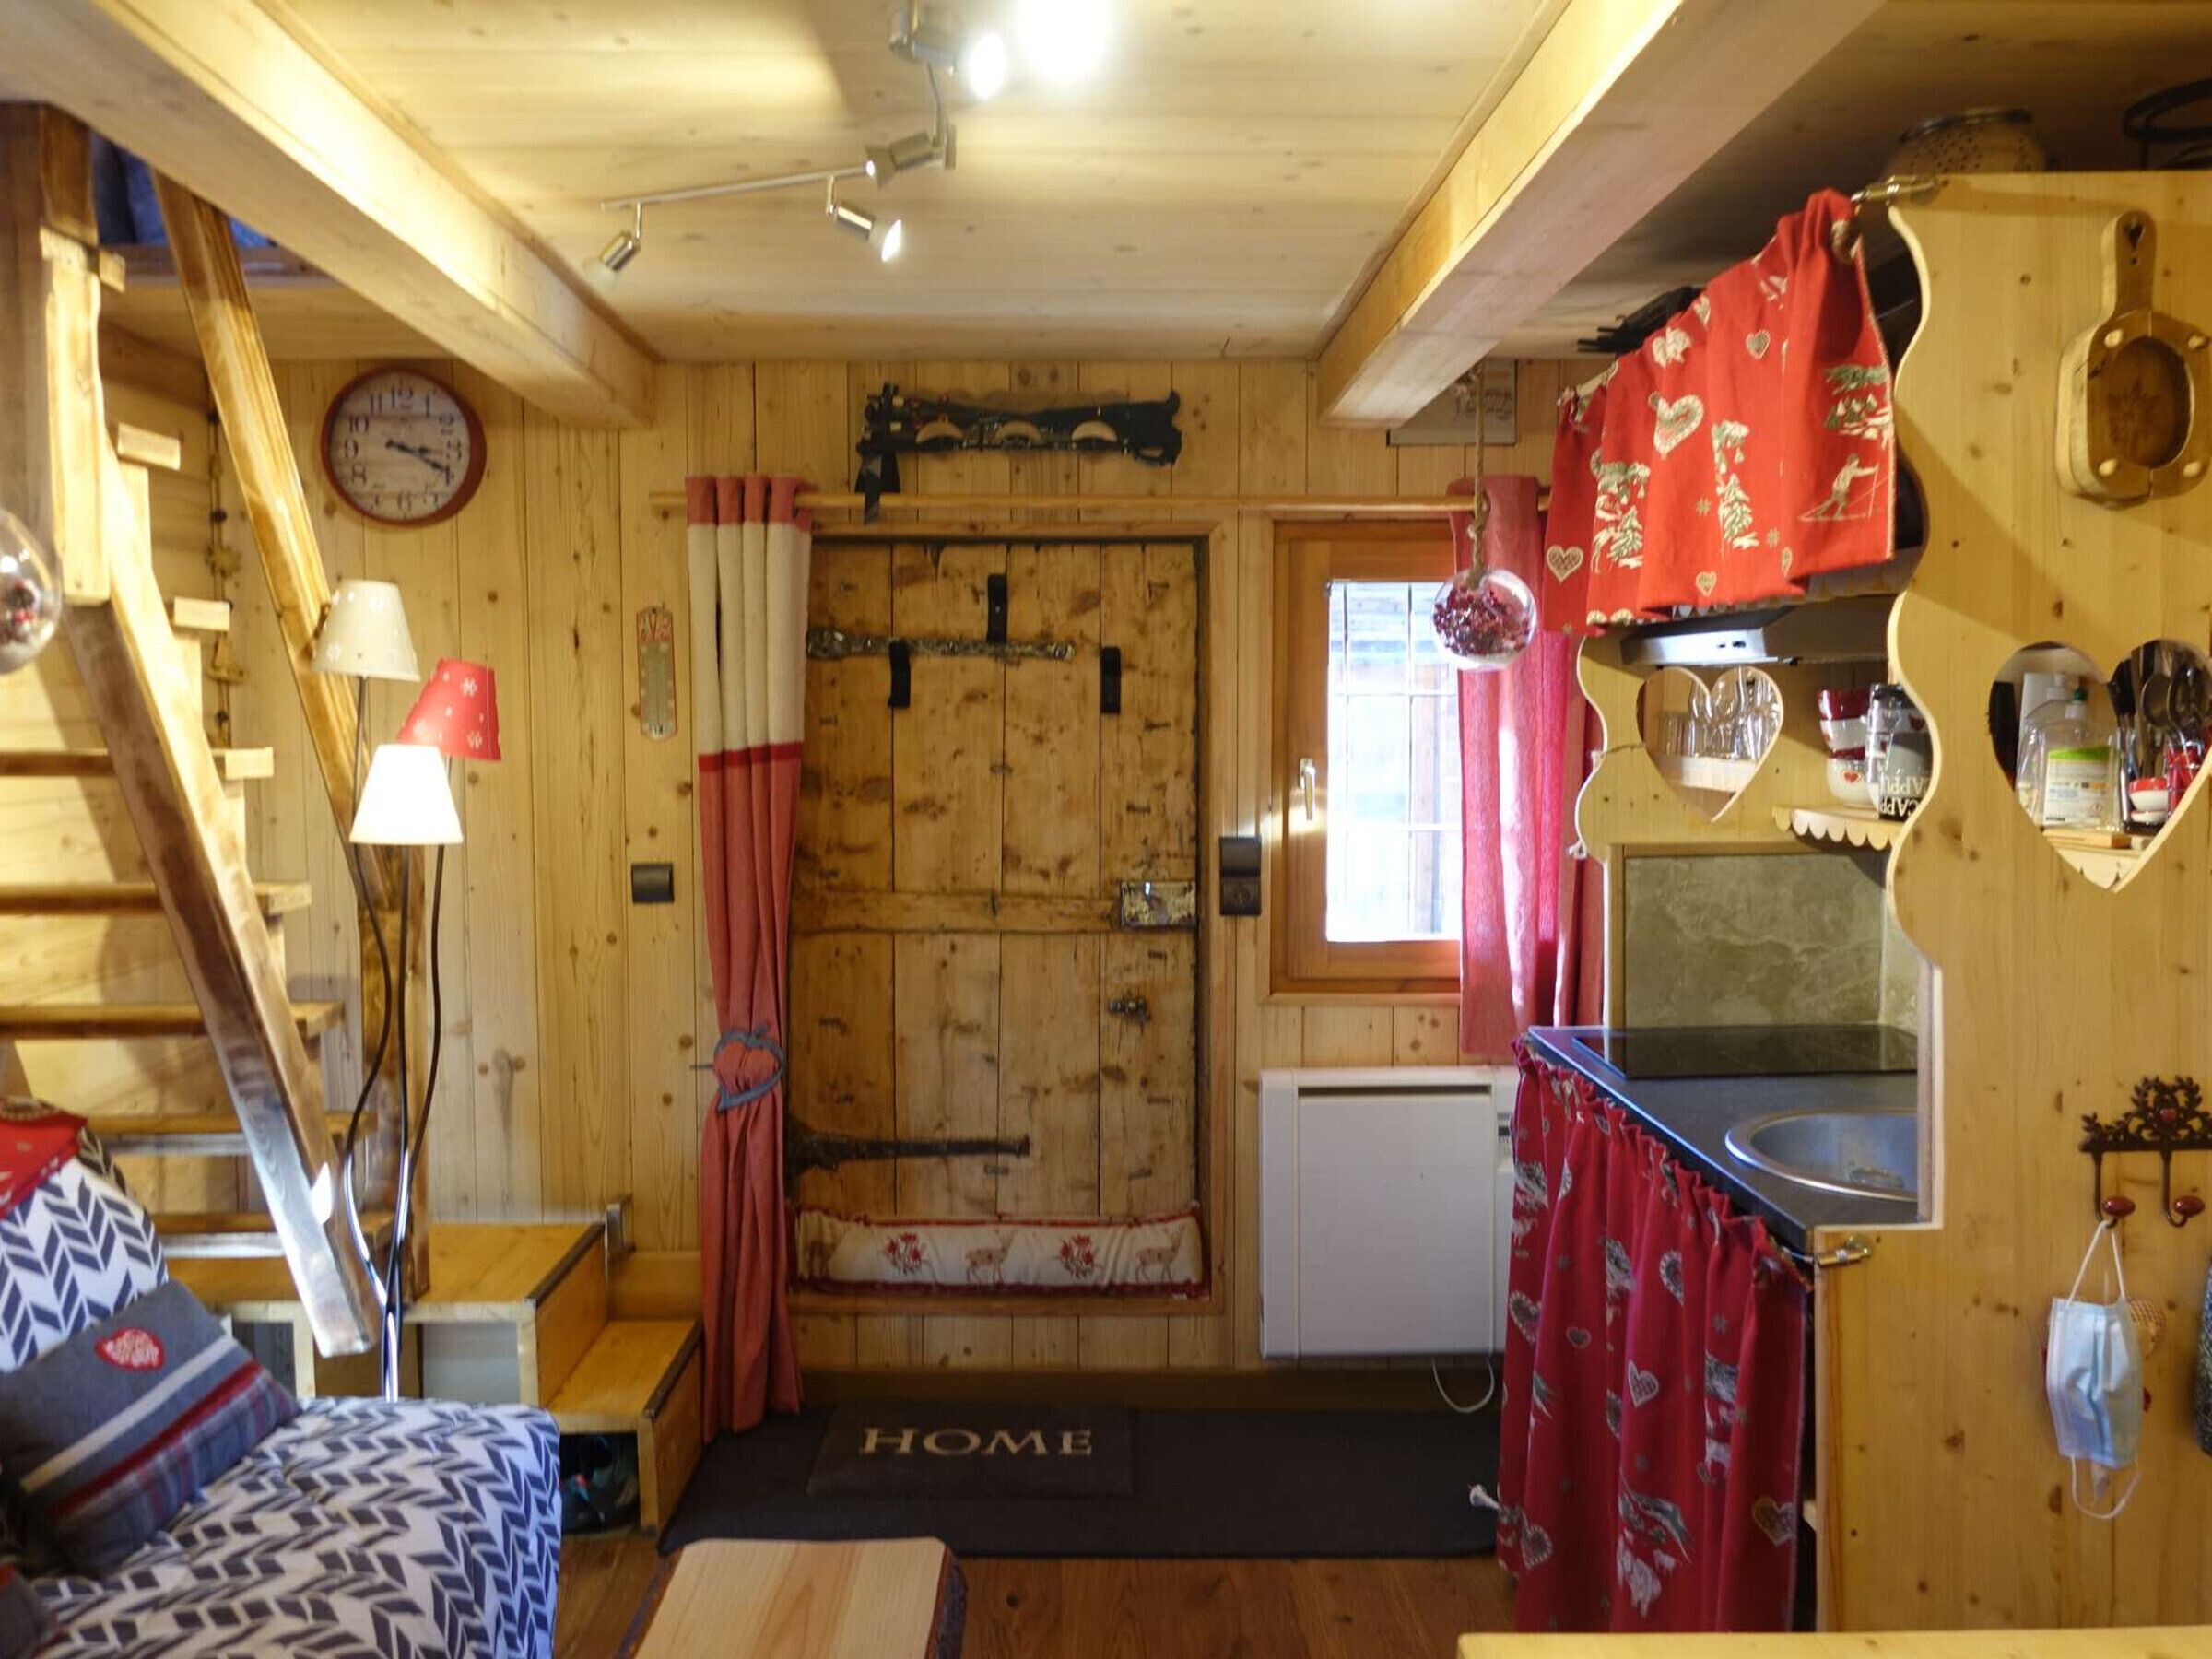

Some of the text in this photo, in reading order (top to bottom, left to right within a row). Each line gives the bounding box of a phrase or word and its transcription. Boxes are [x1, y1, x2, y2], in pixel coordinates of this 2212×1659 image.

[370, 393, 382, 416] 11
[391, 384, 414, 410] 12
[349, 416, 369, 434] 10
[439, 414, 454, 435] 2
[344, 438, 359, 459] 9
[446, 439, 462, 461] 3
[350, 463, 367, 485] 8
[396, 489, 413, 511] 6
[860, 1428, 1093, 1456] HOME
